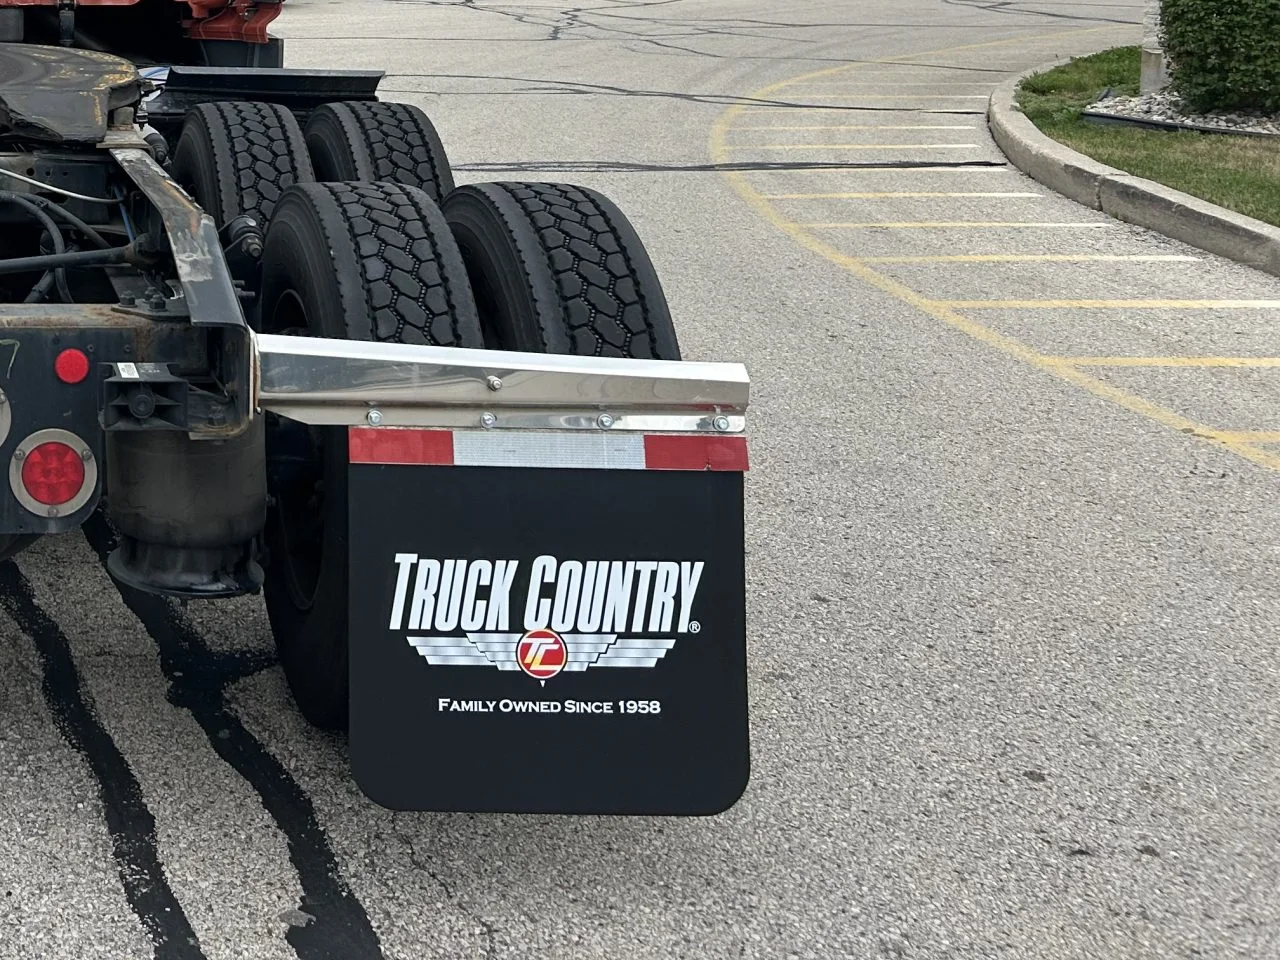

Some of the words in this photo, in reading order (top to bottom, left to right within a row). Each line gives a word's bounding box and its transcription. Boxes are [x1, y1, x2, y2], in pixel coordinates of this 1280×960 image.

[389, 553, 519, 631] TRUCK
[438, 698, 497, 712] FAMILY
[499, 699, 561, 713] OWNED
[564, 700, 613, 713] SINCE
[618, 700, 661, 714] 1958
